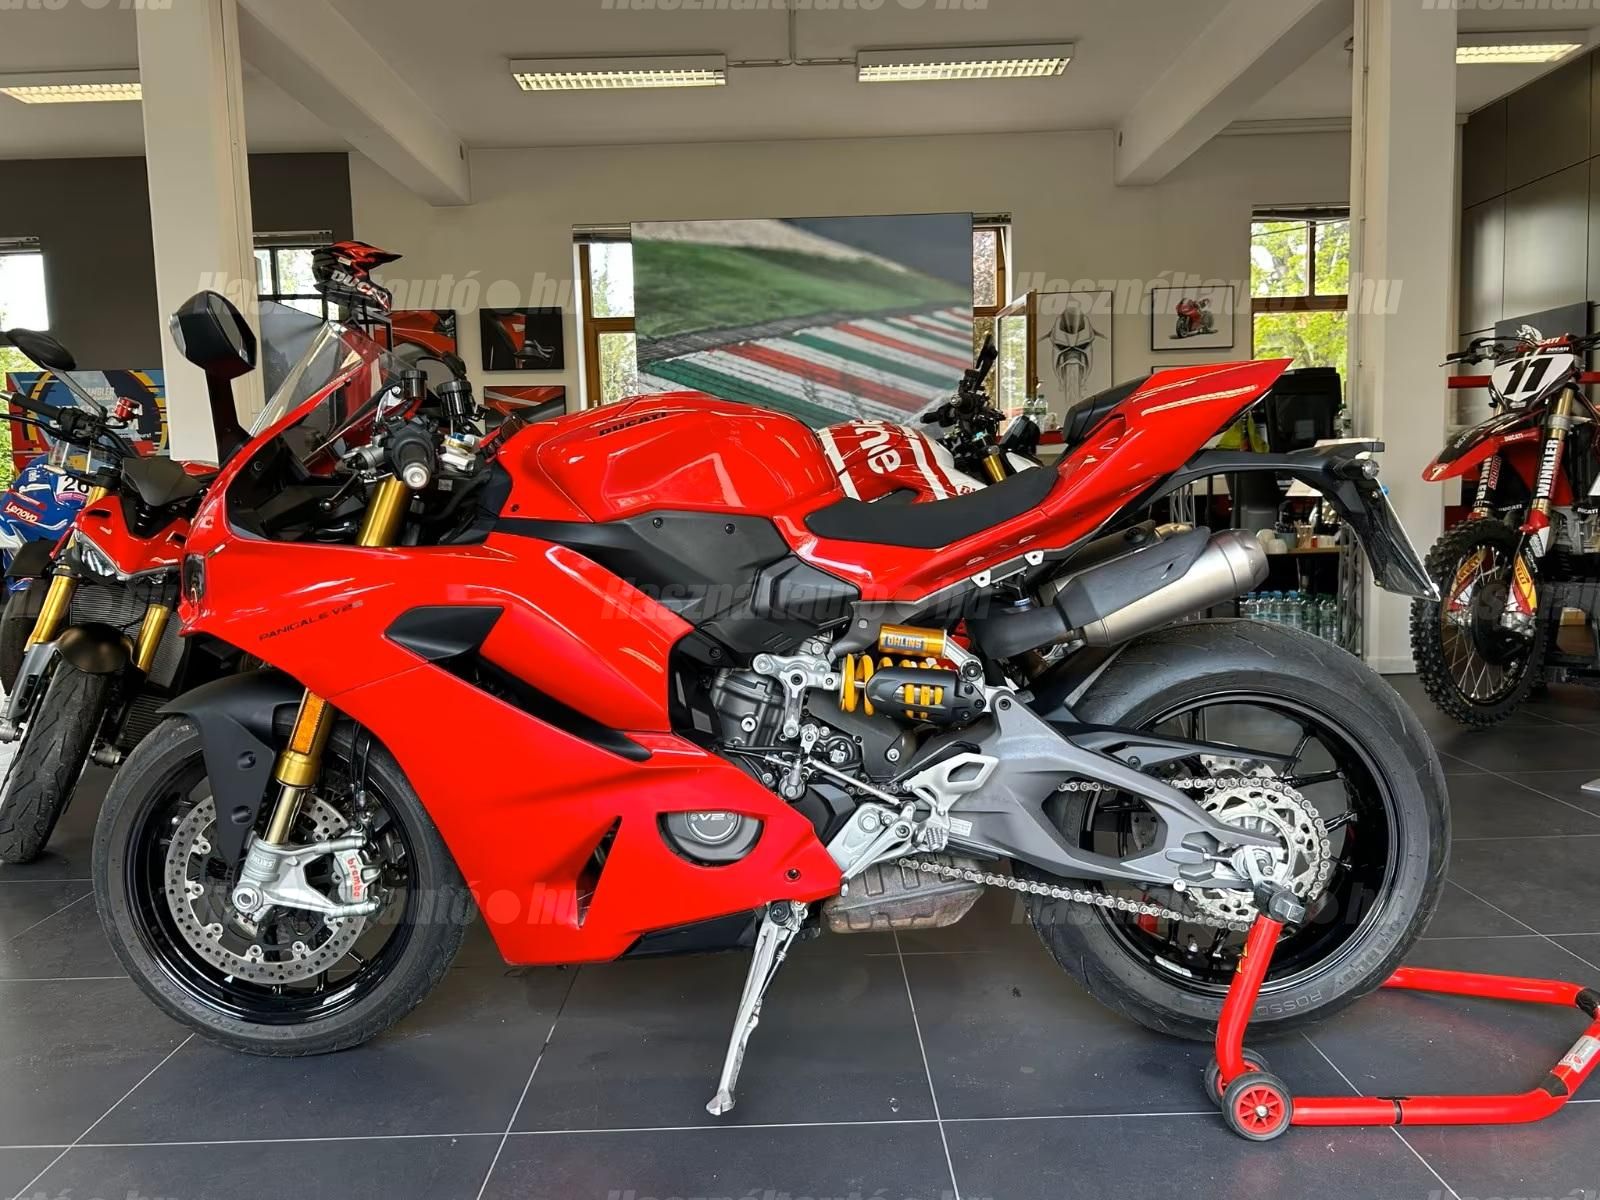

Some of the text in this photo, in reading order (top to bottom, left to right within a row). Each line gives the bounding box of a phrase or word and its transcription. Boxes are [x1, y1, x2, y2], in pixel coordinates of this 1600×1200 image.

[1503, 357, 1554, 395] 11
[599, 411, 667, 436] DUCATI
[1504, 432, 1524, 443] DUCATI
[1536, 439, 1559, 497] WINKLER
[4, 502, 39, 523] Lenovo
[699, 813, 726, 821] V2
[346, 857, 361, 897] brembo
